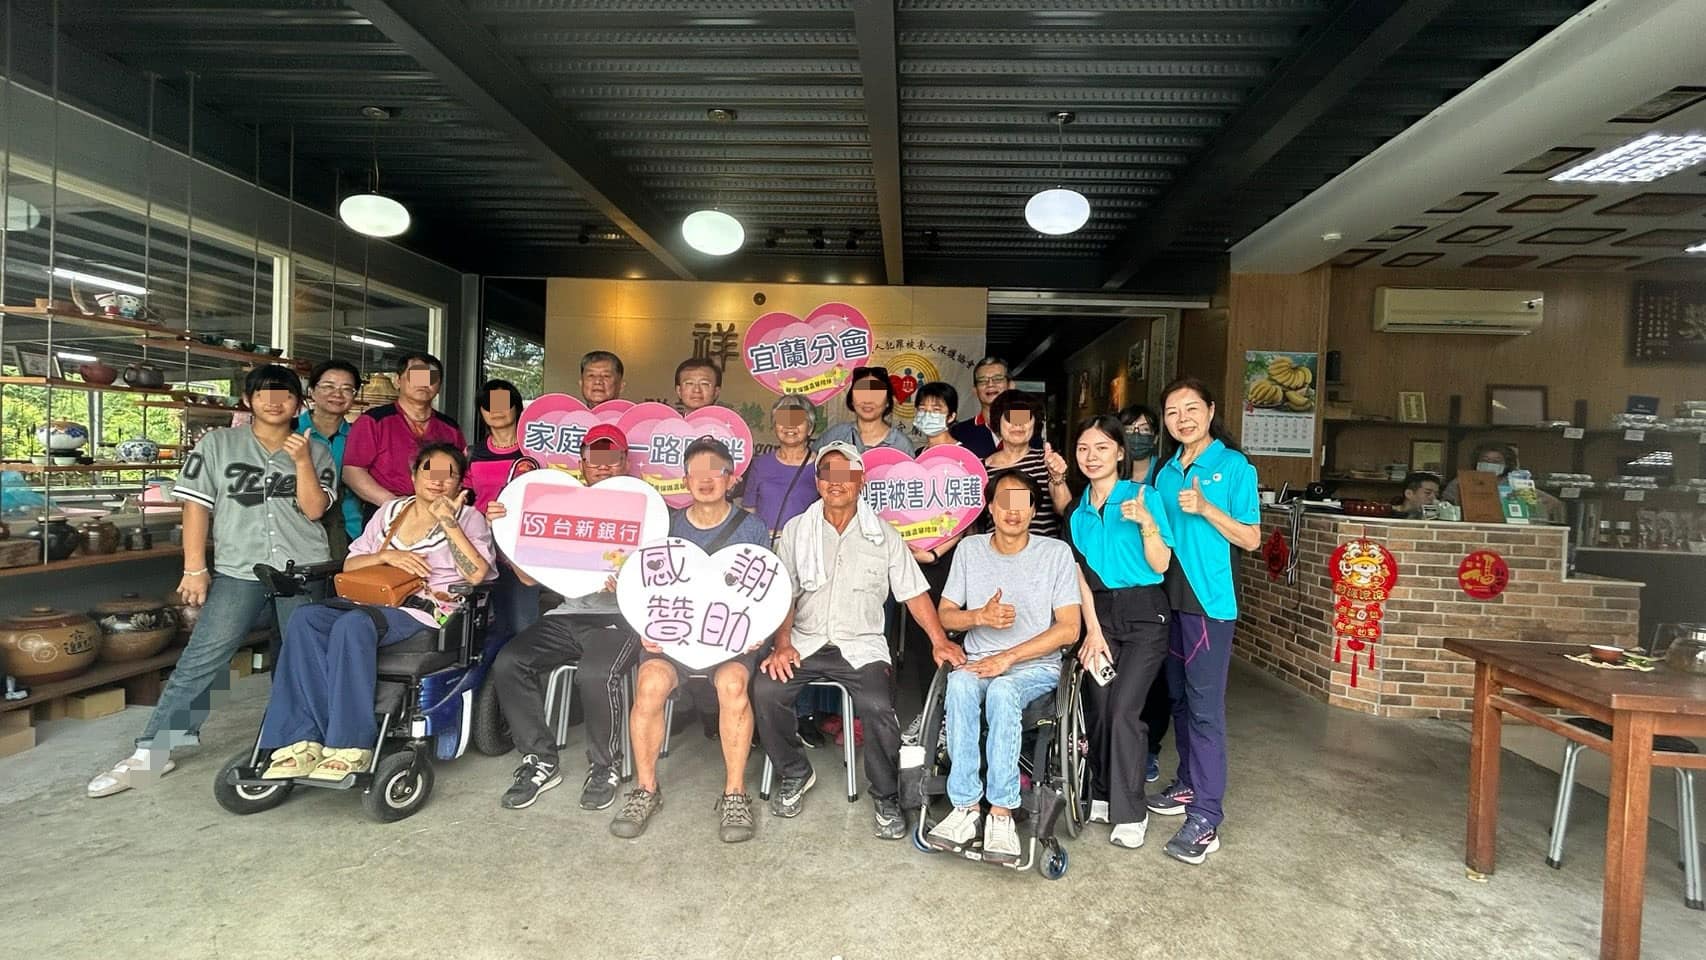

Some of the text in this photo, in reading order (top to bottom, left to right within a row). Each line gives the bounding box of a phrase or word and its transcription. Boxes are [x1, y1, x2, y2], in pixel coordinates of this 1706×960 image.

[692, 322, 739, 372] 祥
[749, 327, 868, 374] 宜蘭分會
[872, 338, 976, 369] 人犯罪被害人保護協會
[525, 422, 587, 455] 家庭
[628, 435, 745, 465] 一路伴
[224, 462, 297, 497] Tige
[552, 519, 639, 543] 台新銀行
[639, 540, 779, 603] 感謝
